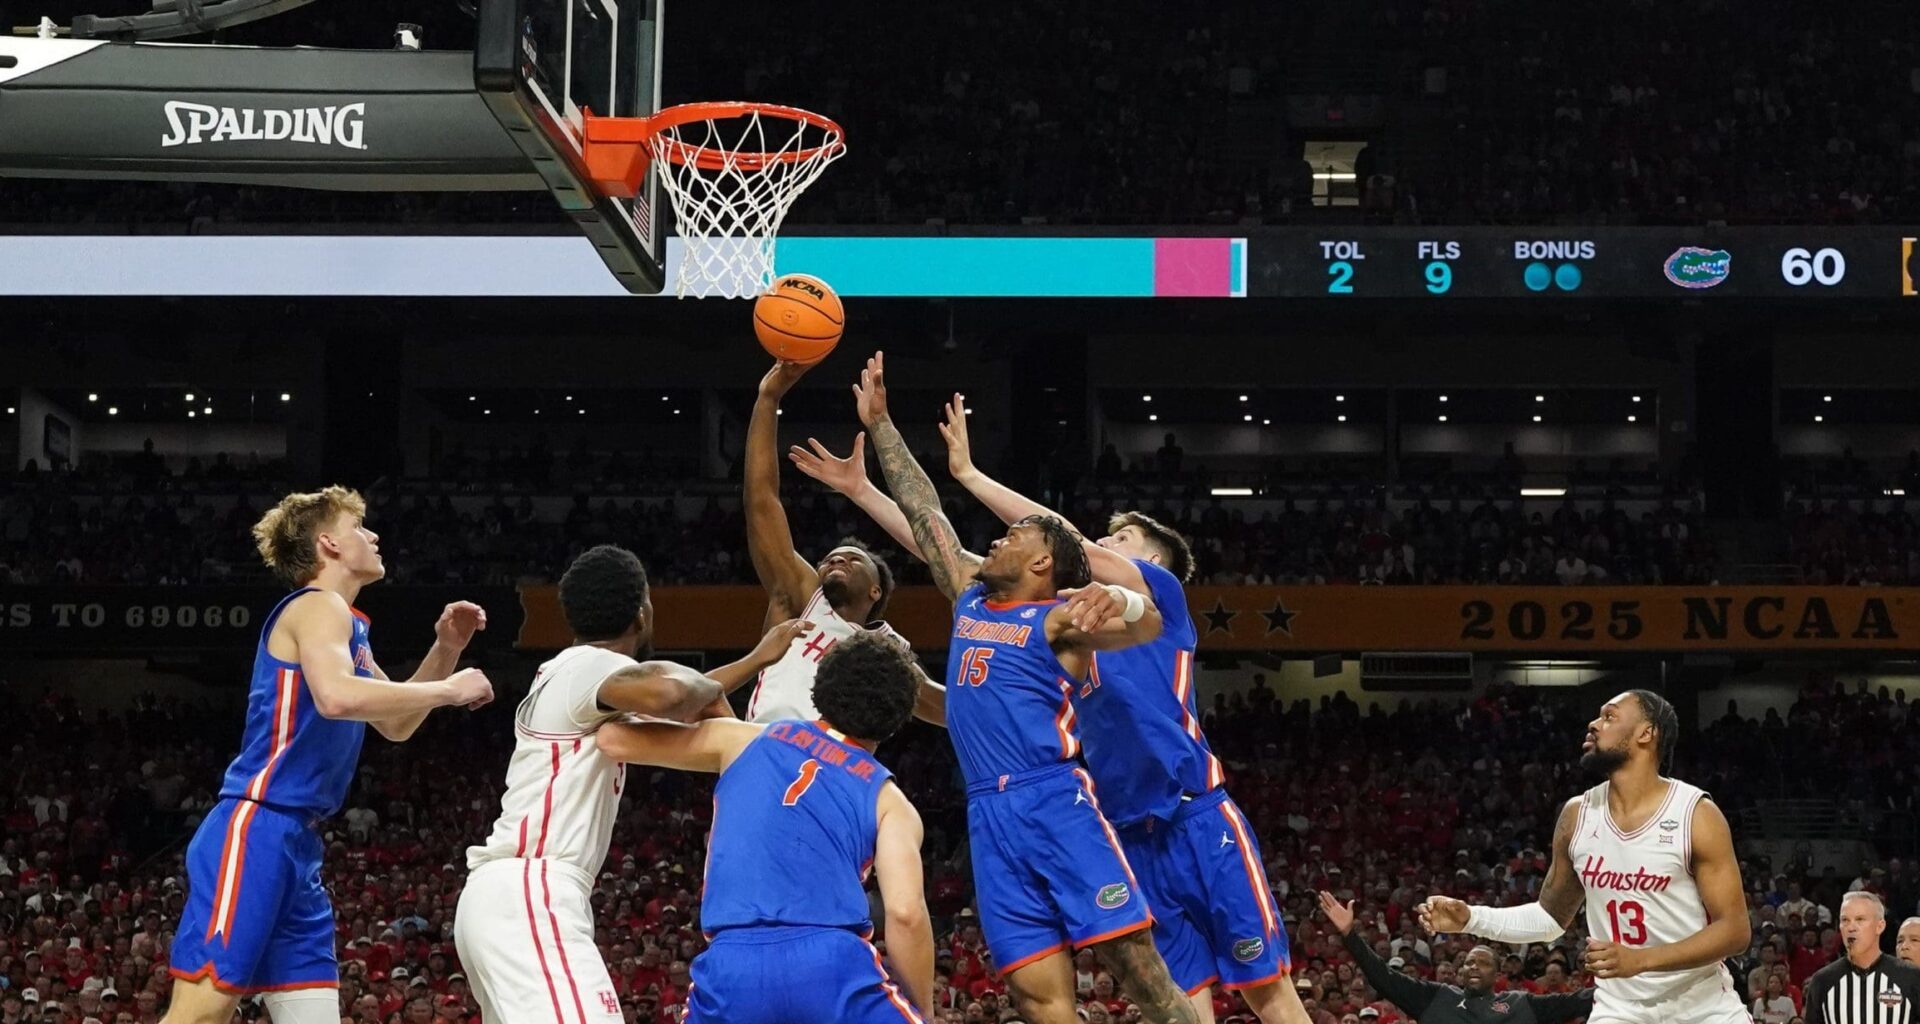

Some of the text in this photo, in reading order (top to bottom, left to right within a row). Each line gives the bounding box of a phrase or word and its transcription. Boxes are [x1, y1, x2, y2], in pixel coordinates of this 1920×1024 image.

[161, 100, 365, 150] SPALDING
[1320, 241, 1365, 260] TOL
[1418, 241, 1461, 260] FLS
[1514, 241, 1596, 260] BONUS
[1781, 247, 1846, 286] 60
[780, 278, 825, 301] NCAA
[1327, 261, 1354, 293] 2
[1424, 261, 1452, 294] 9
[0, 603, 251, 628] S TO 69060
[954, 615, 1032, 648] FLORIDA
[1461, 596, 1899, 641] 2025 NCAA
[957, 646, 995, 688] 15
[767, 722, 851, 768] CLAYTON
[782, 758, 823, 806] 1
[1581, 854, 1672, 892] Houston
[1606, 899, 1648, 946] 13
